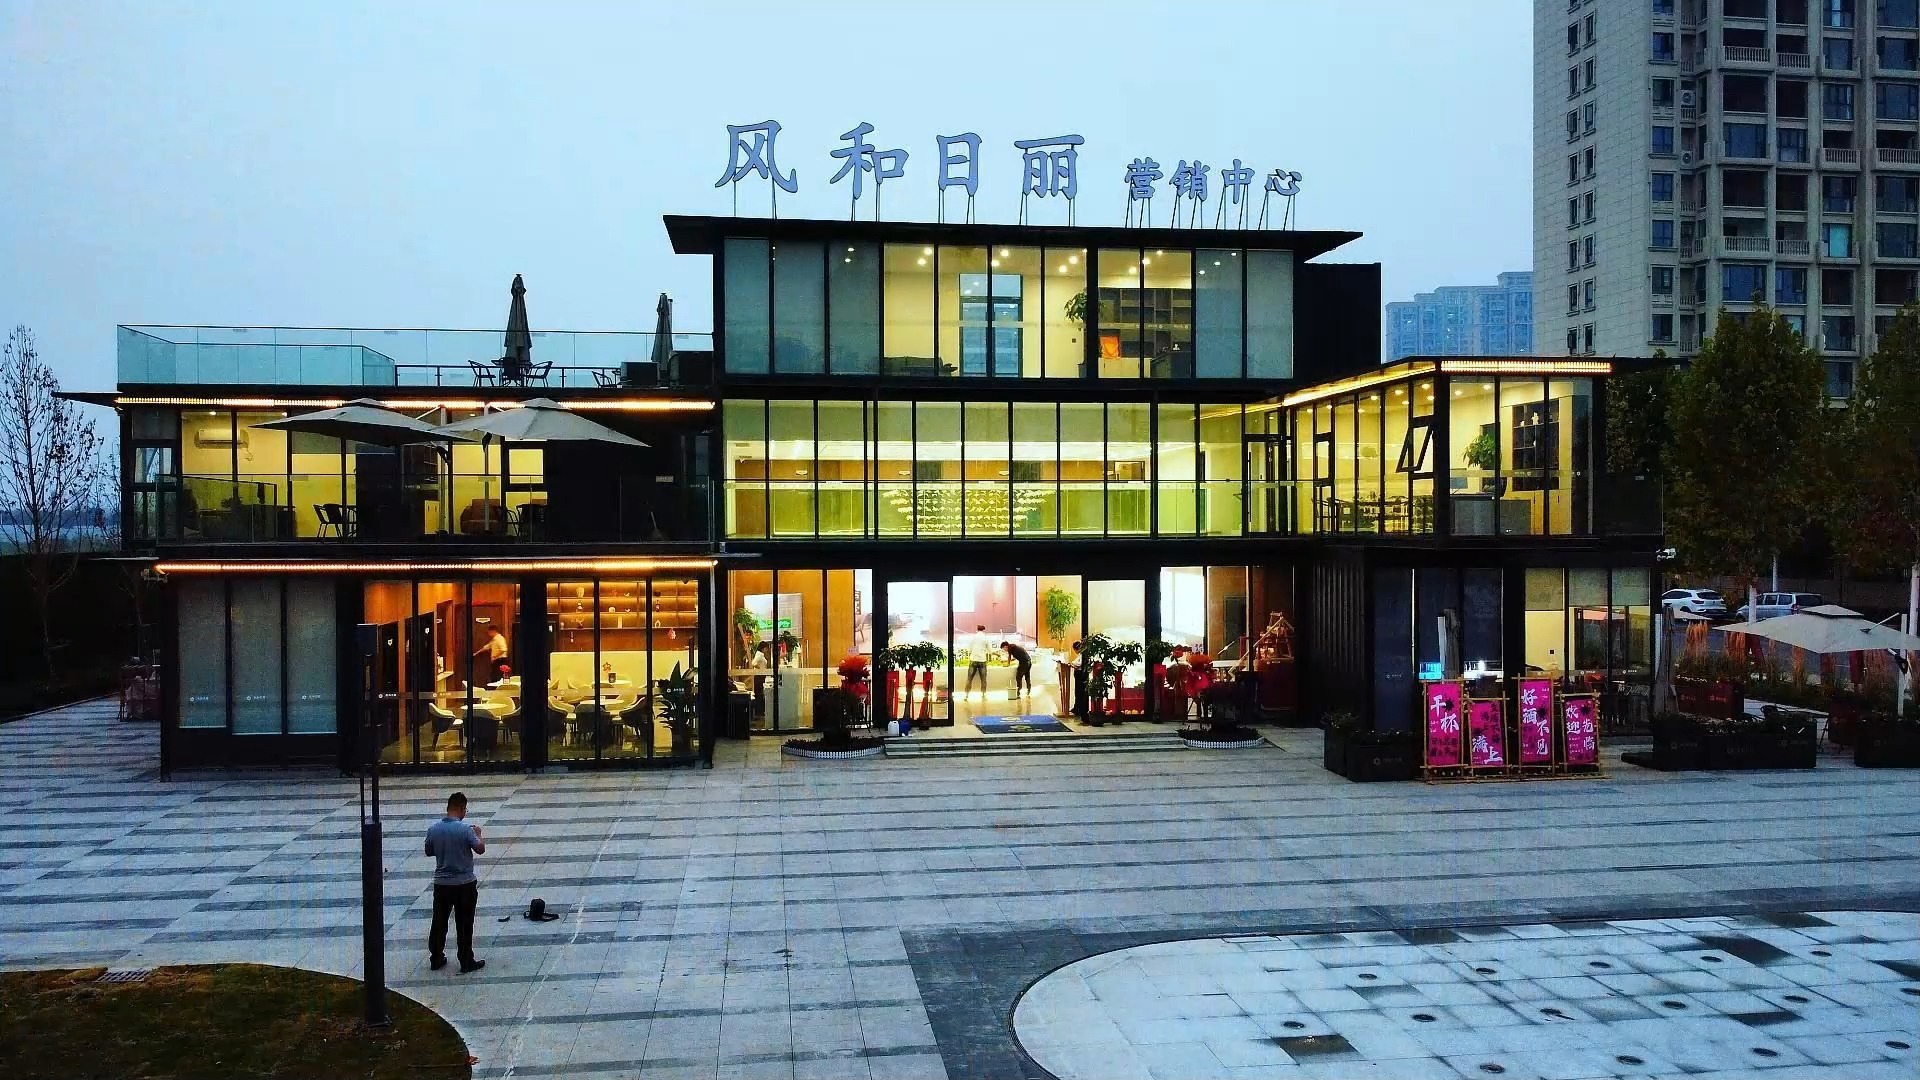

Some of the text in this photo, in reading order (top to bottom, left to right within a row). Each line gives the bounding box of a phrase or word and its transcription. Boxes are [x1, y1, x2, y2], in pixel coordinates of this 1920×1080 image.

[715, 120, 1085, 200] 风和日丽
[1124, 157, 1302, 204] 营销中心
[1430, 694, 1460, 734] 干杯
